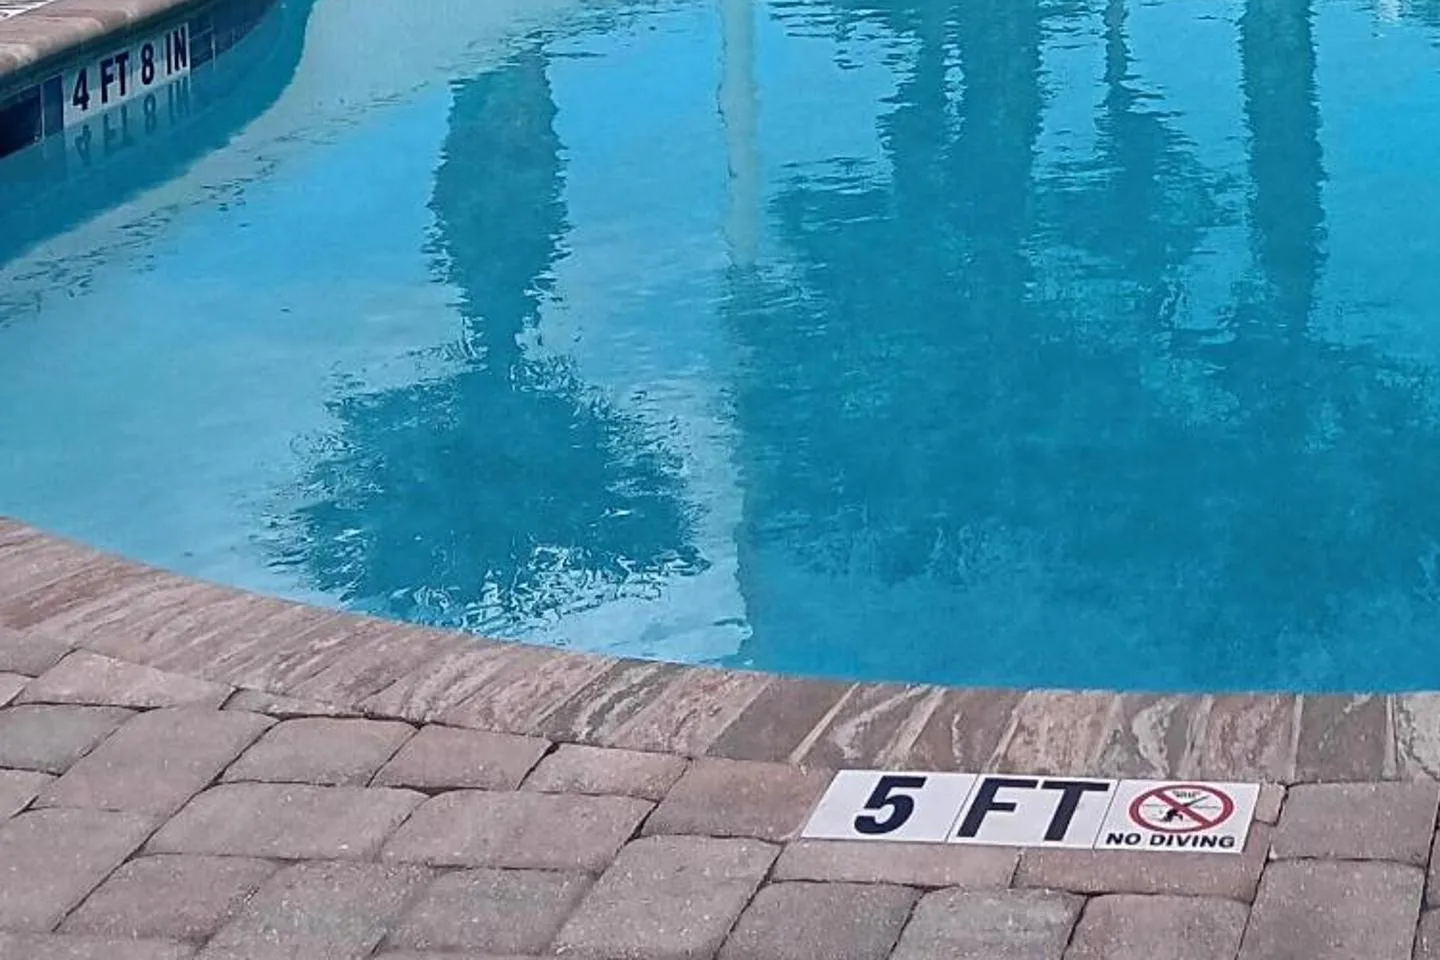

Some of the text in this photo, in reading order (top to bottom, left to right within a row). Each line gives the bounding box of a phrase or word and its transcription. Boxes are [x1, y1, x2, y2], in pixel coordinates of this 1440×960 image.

[72, 26, 188, 111] 4 FT 8 IN
[854, 776, 1109, 841] 5 FT
[1106, 832, 1235, 848] NO DIVING
